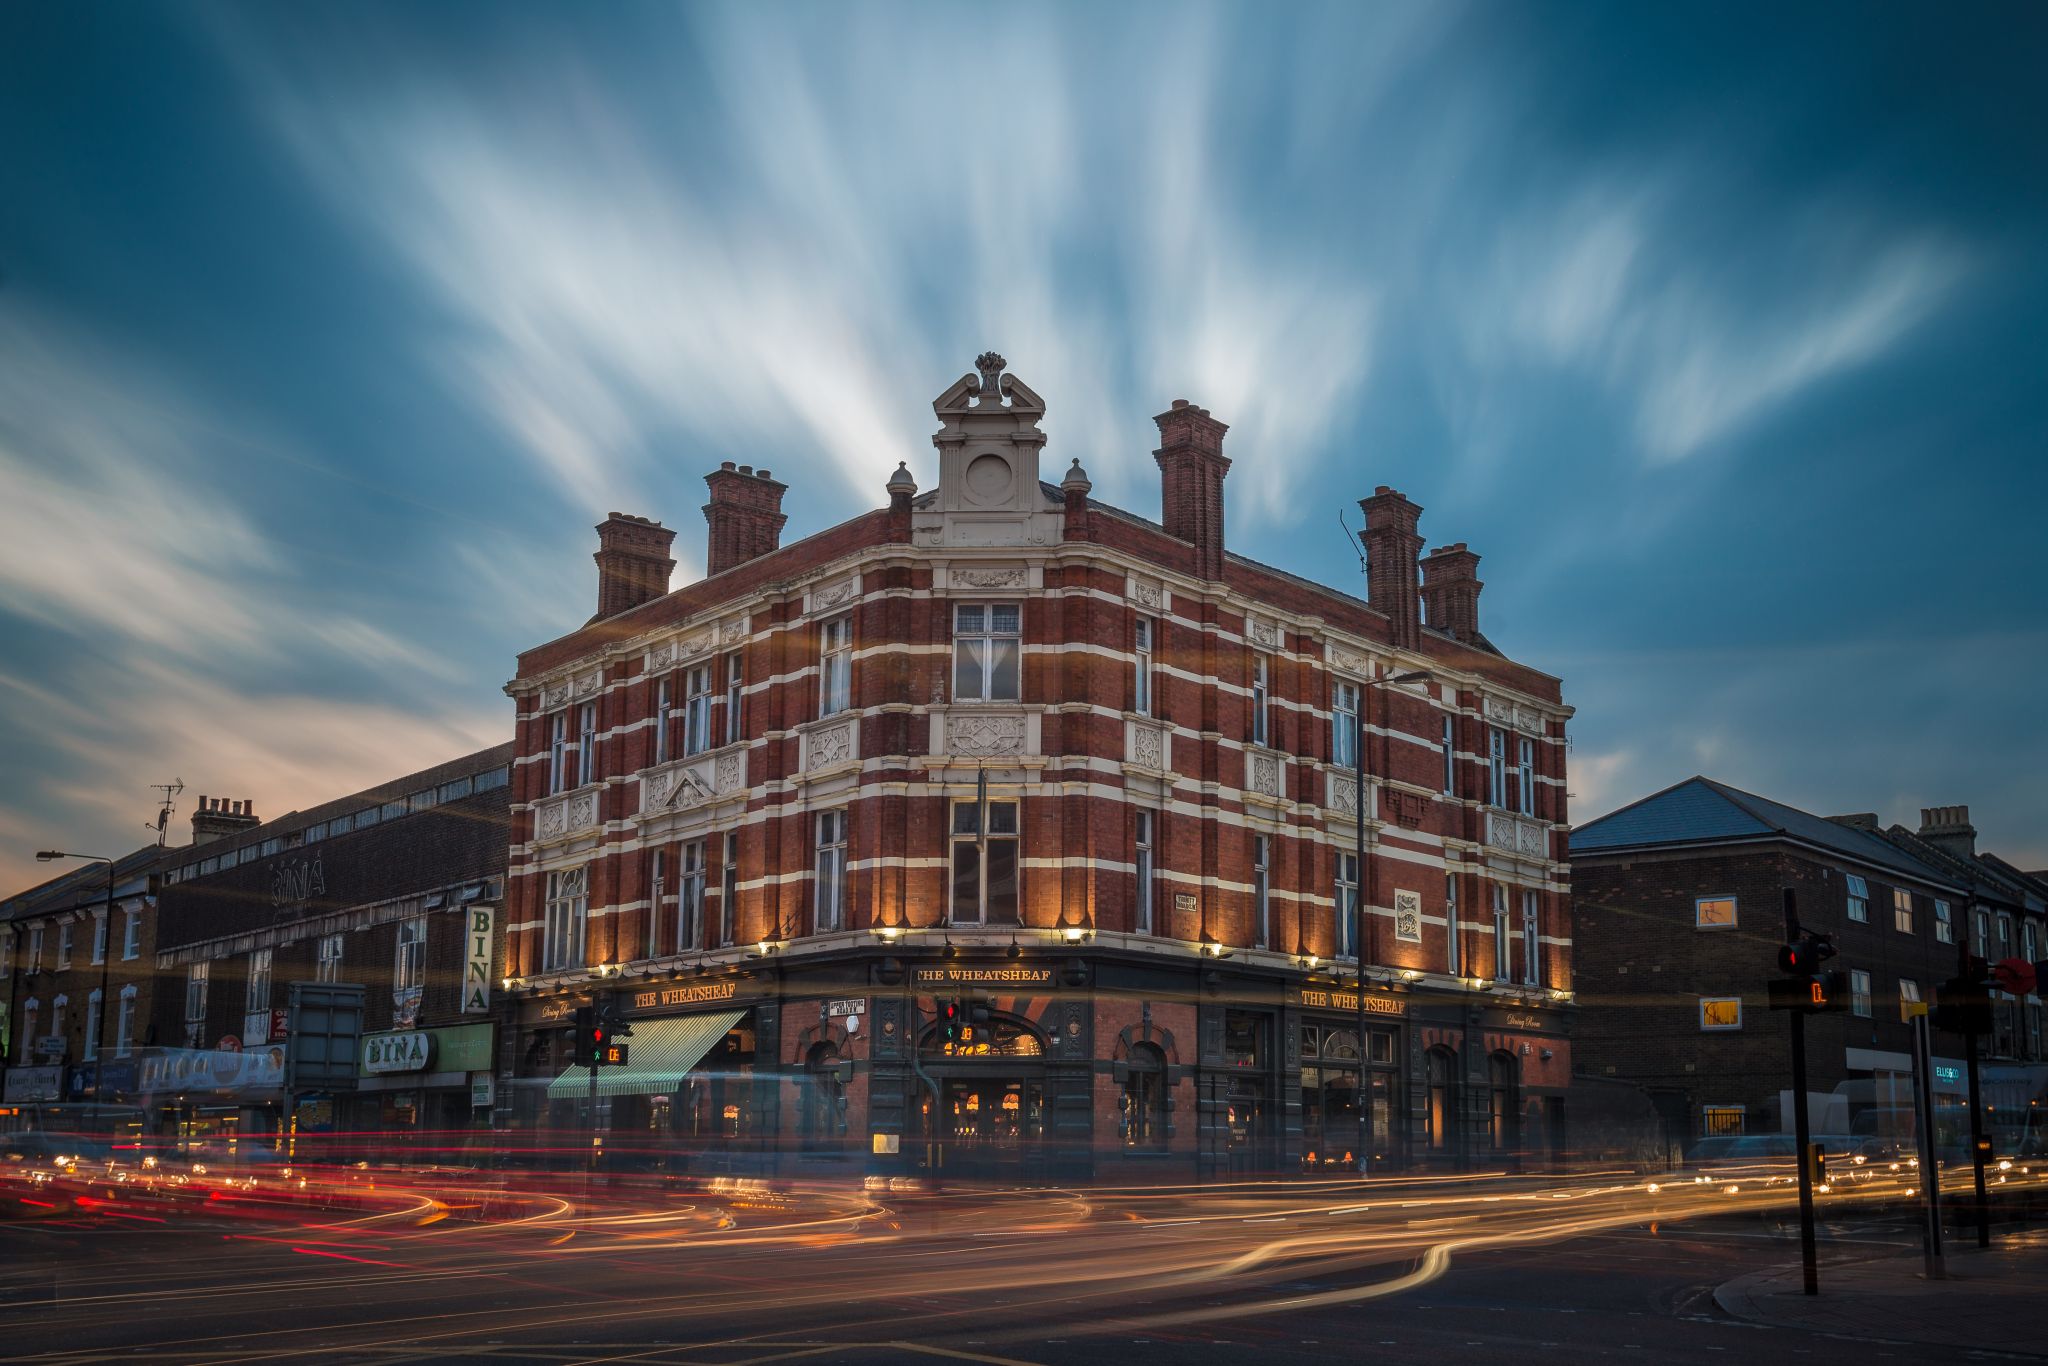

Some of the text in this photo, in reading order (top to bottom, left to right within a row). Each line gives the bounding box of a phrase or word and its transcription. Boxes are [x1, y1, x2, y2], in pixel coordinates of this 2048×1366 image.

[467, 911, 490, 1009] BINA
[917, 970, 1051, 981] THE WHEATSHEAF
[635, 983, 736, 1008] THE WHEATSHEAF
[845, 1000, 863, 1008] TOOTING
[1301, 990, 1405, 1015] THE WHETSHEAF
[1506, 1014, 1541, 1029] Dining Room
[369, 1038, 423, 1063] BINA
